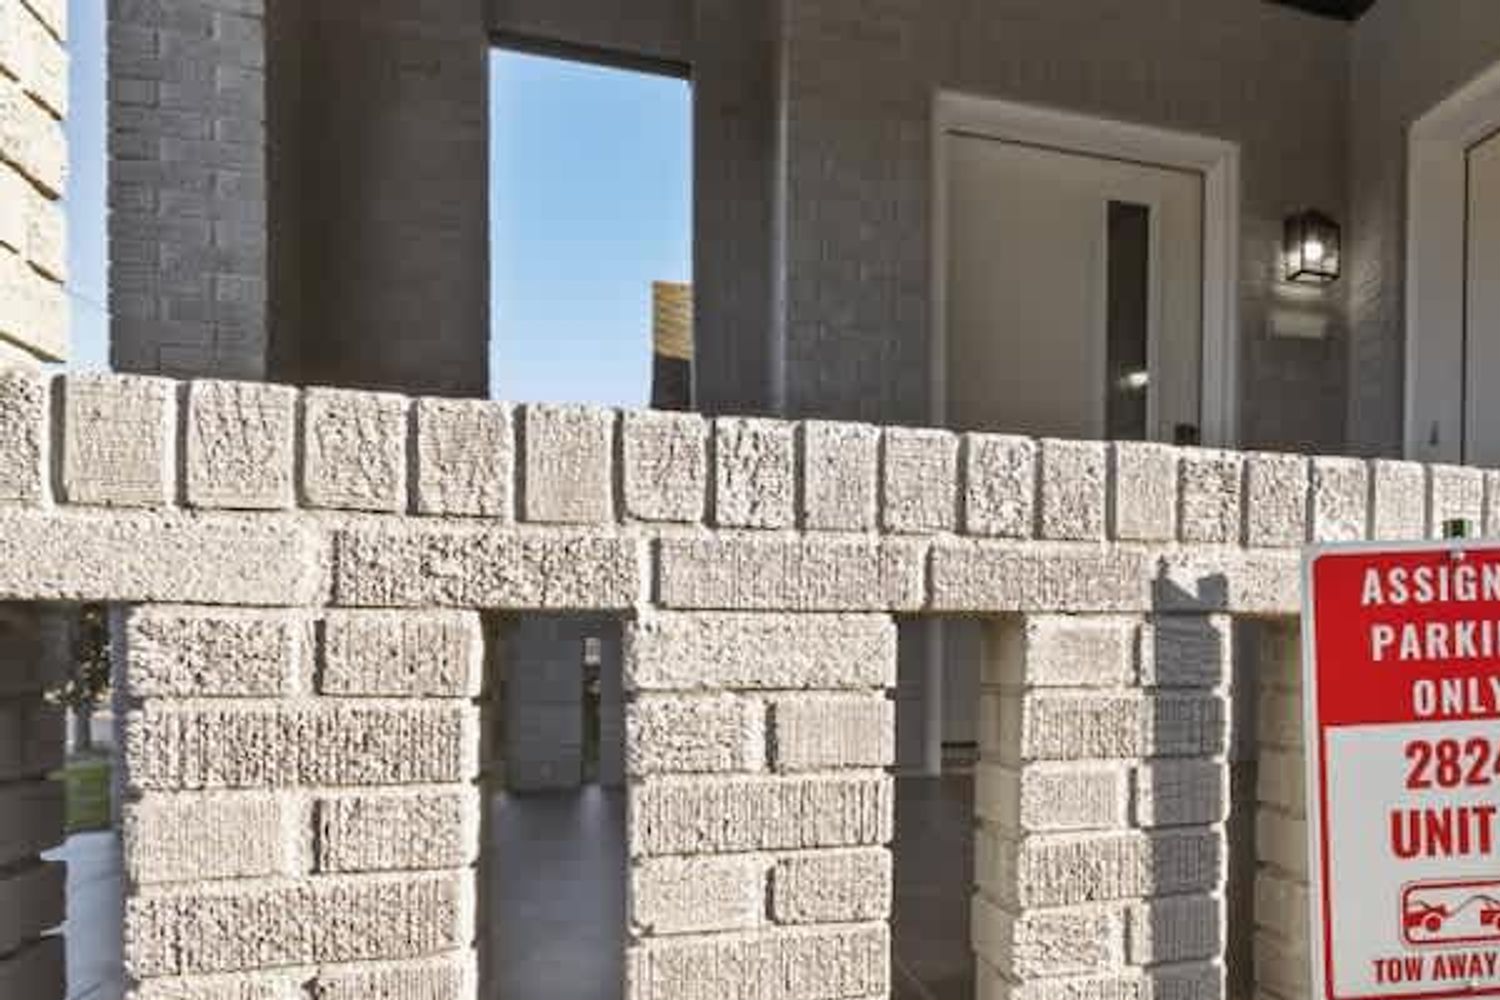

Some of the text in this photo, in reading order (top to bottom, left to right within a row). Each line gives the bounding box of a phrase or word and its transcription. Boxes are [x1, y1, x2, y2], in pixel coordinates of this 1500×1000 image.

[1390, 805, 1497, 859] UNIT
[1372, 957, 1428, 984] TOW
[1433, 952, 1496, 981] AWAY
